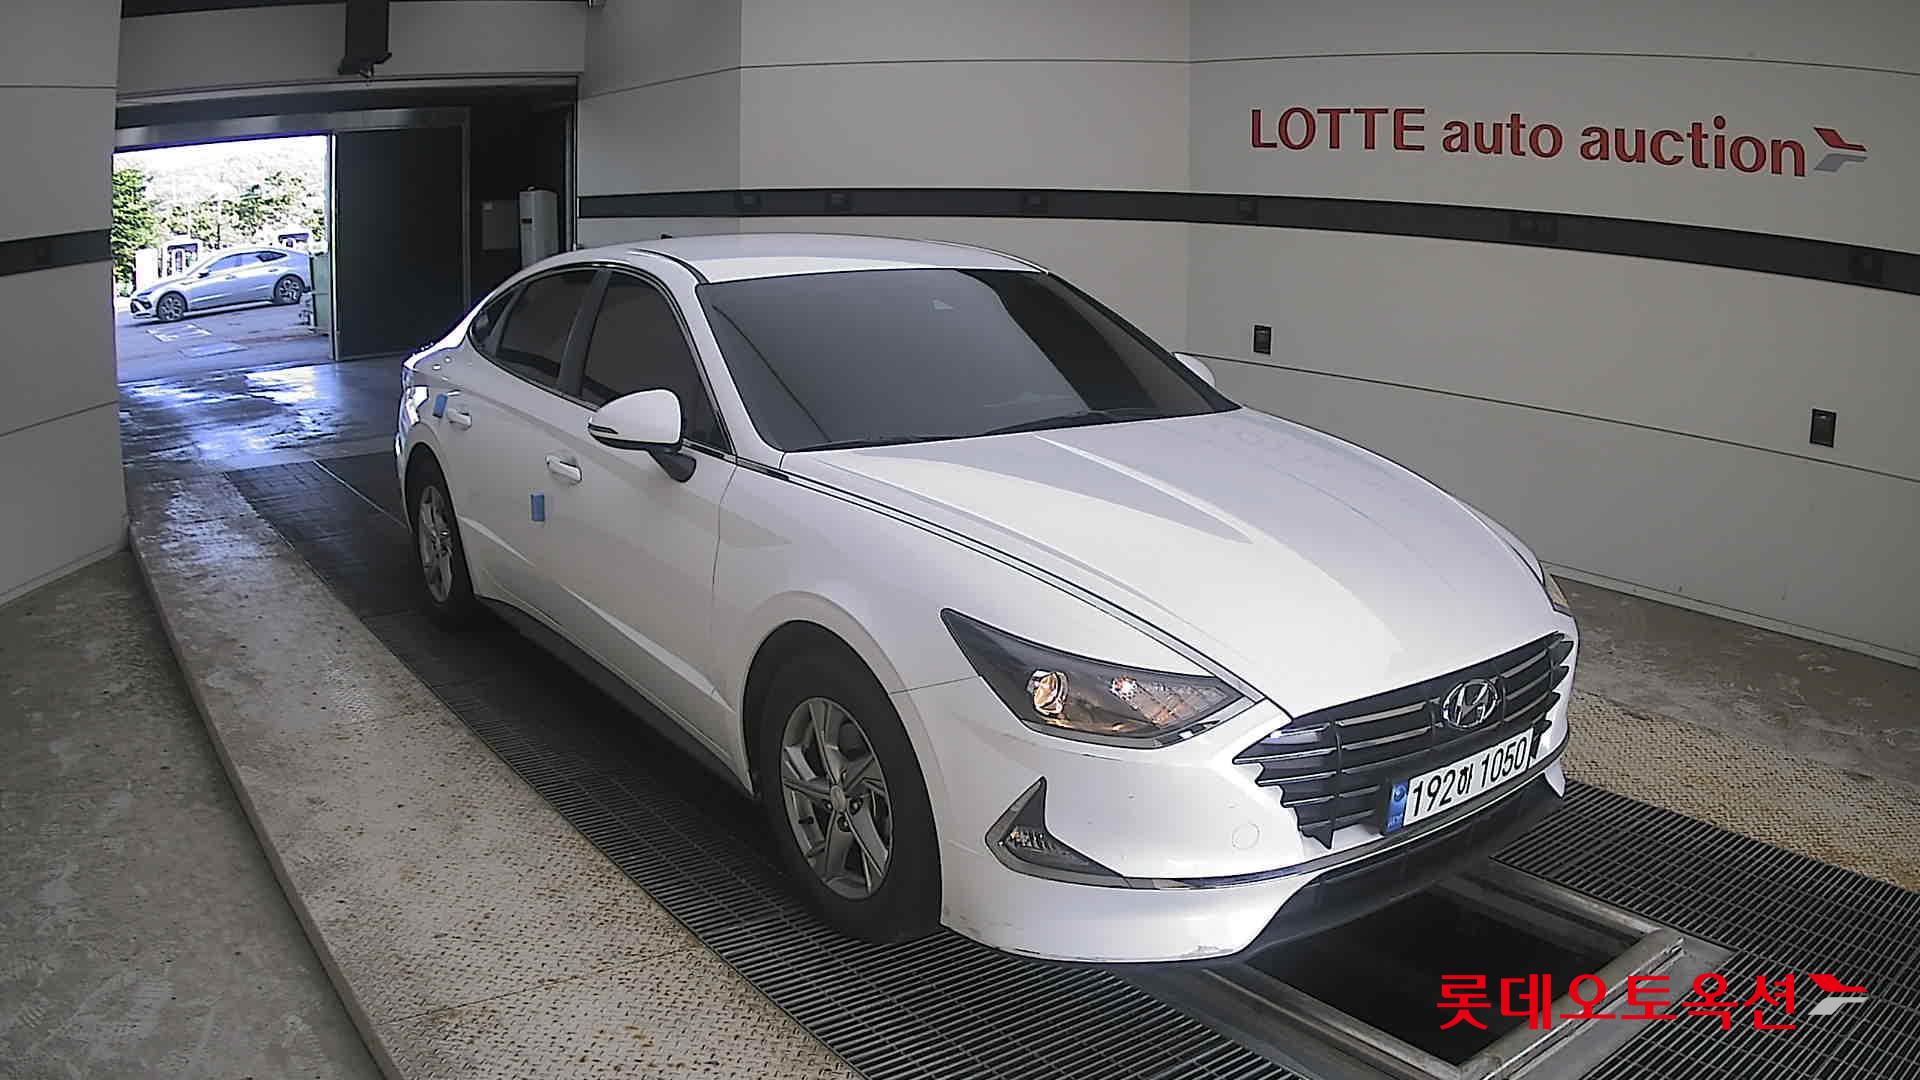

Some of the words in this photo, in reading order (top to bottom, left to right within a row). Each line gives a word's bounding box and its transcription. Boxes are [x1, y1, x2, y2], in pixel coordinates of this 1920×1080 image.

[1250, 107, 1426, 151] LOTTE
[1442, 112, 1564, 158] auto
[1581, 116, 1806, 177] auction
[1413, 765, 1473, 817] 192하
[1480, 737, 1527, 788] 1050
